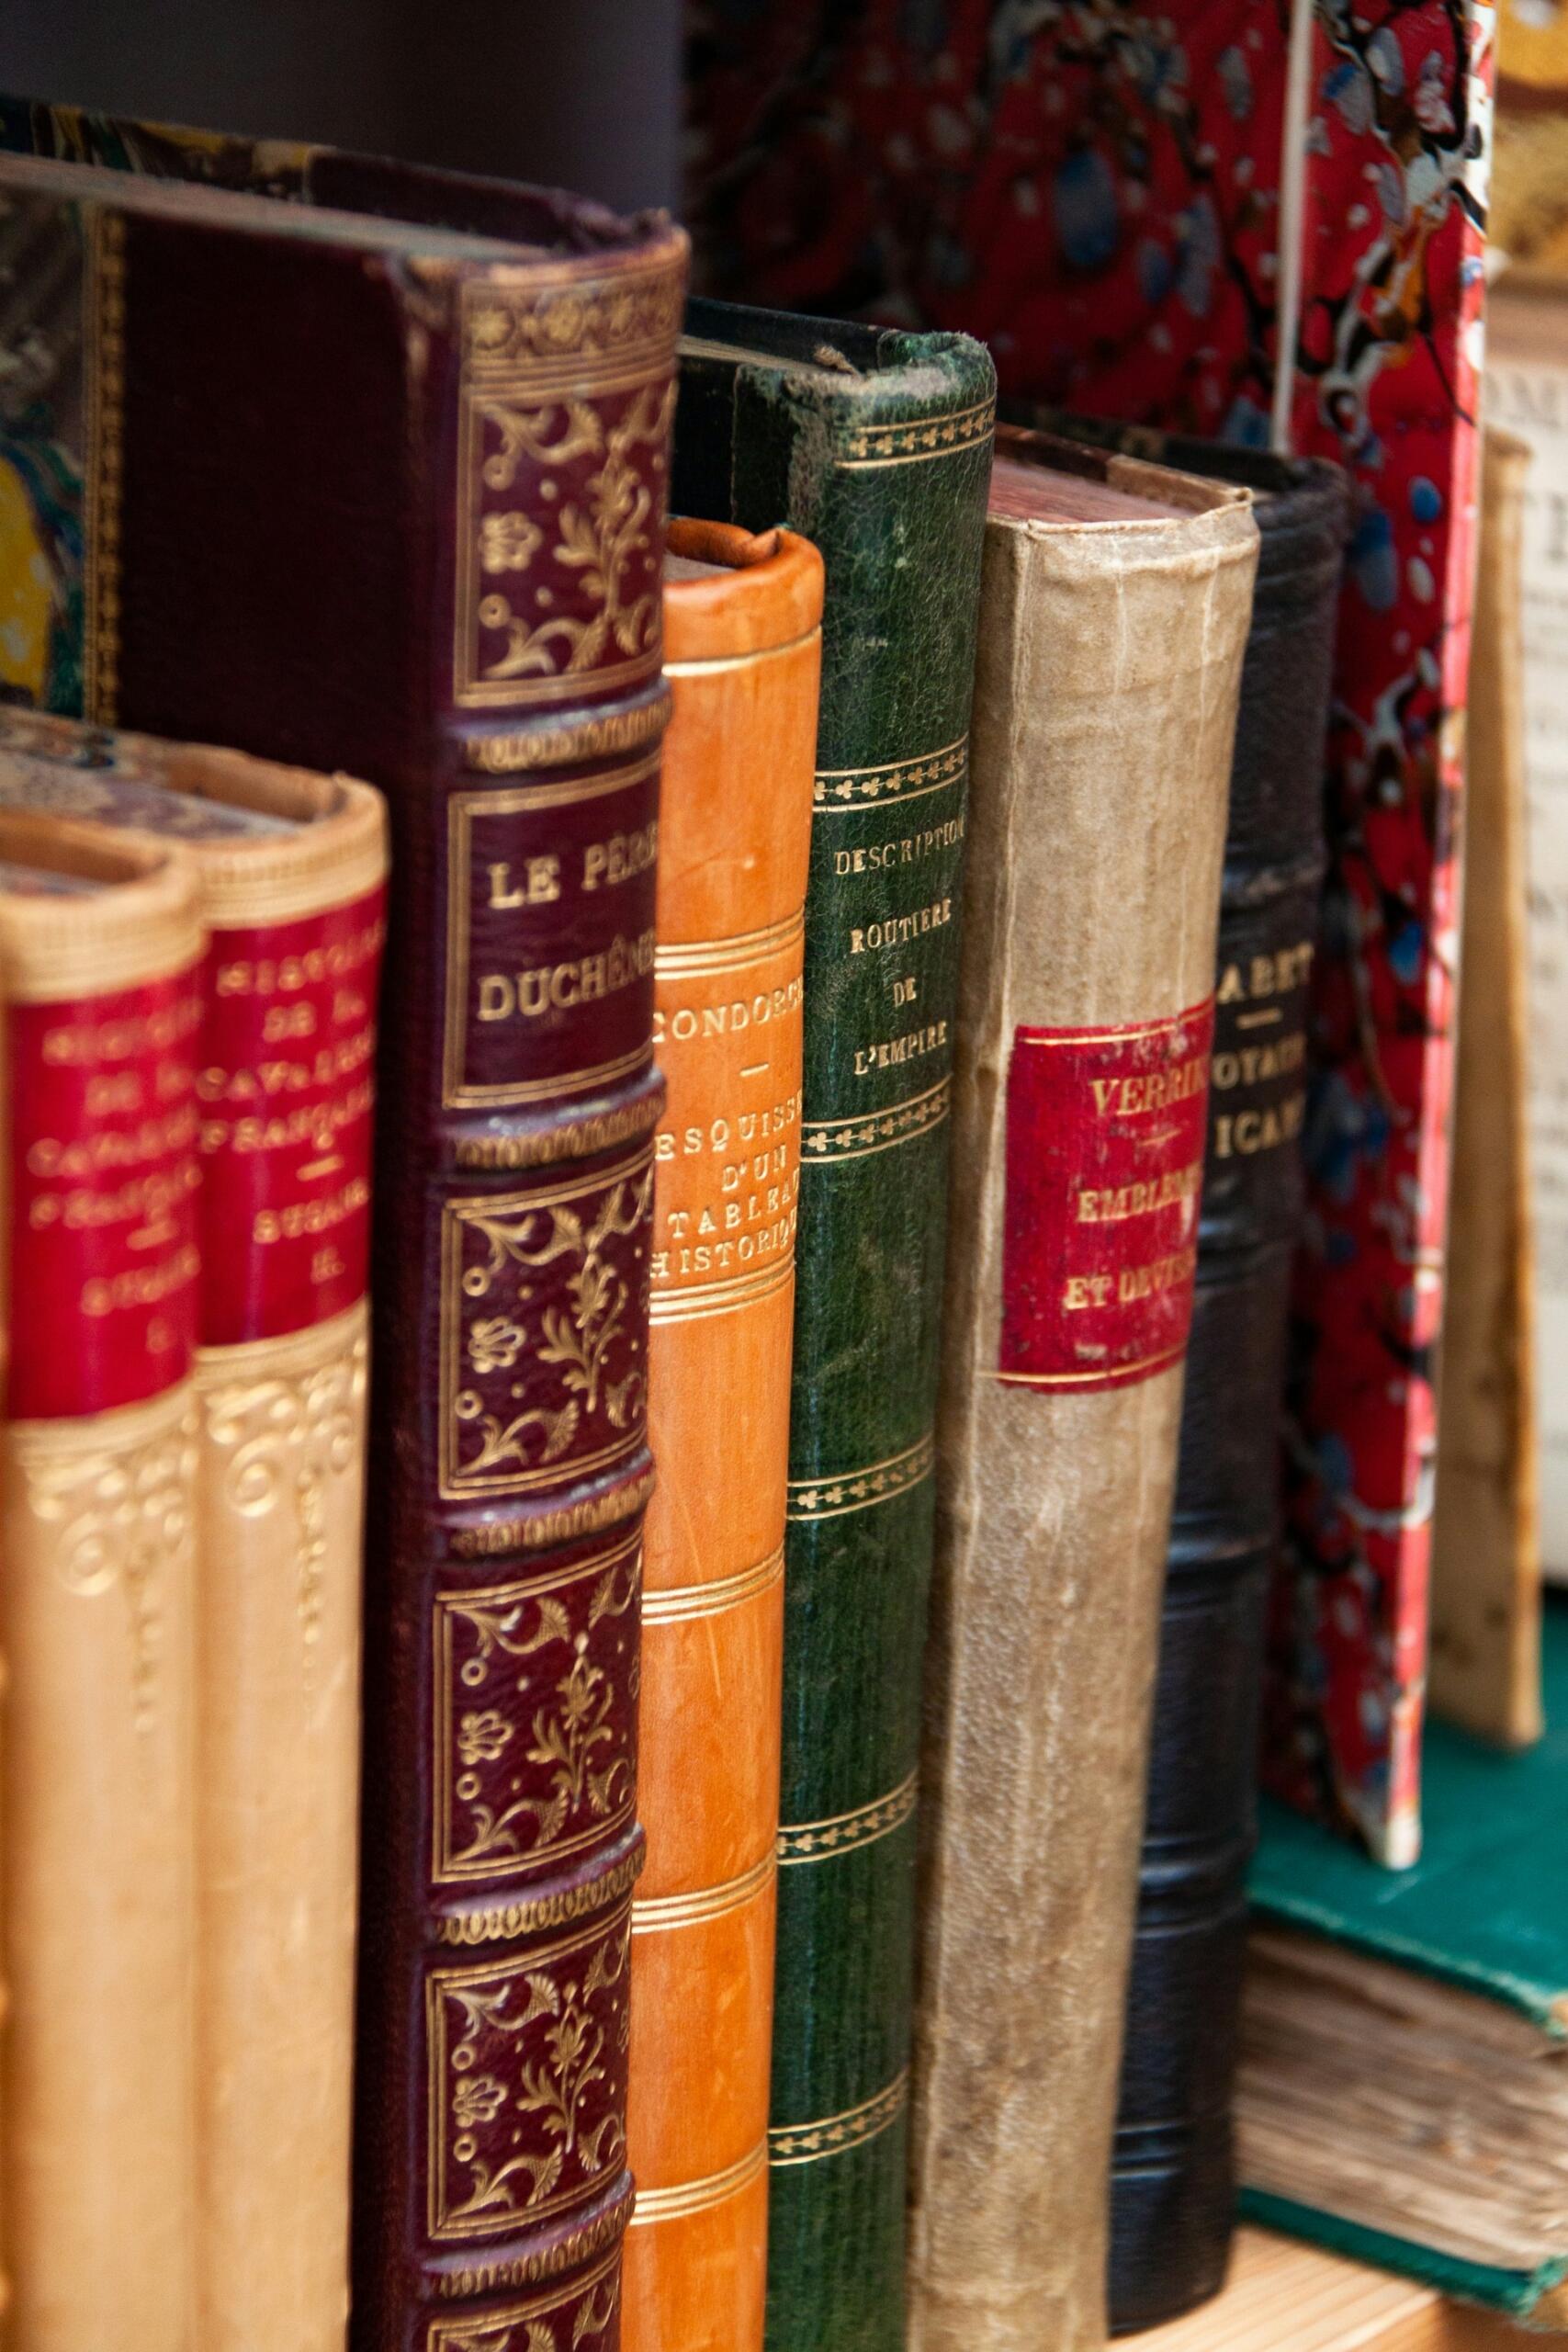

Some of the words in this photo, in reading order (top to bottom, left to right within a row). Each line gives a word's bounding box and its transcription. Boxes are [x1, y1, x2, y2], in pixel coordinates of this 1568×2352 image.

[487, 854, 560, 910] LE
[849, 897, 952, 954] ROUTIERE
[892, 977, 917, 1008] DE
[853, 1020, 947, 1076] L'EMPIRE
[721, 1145, 786, 1193] D'UN
[1063, 1275, 1112, 1310] ET
